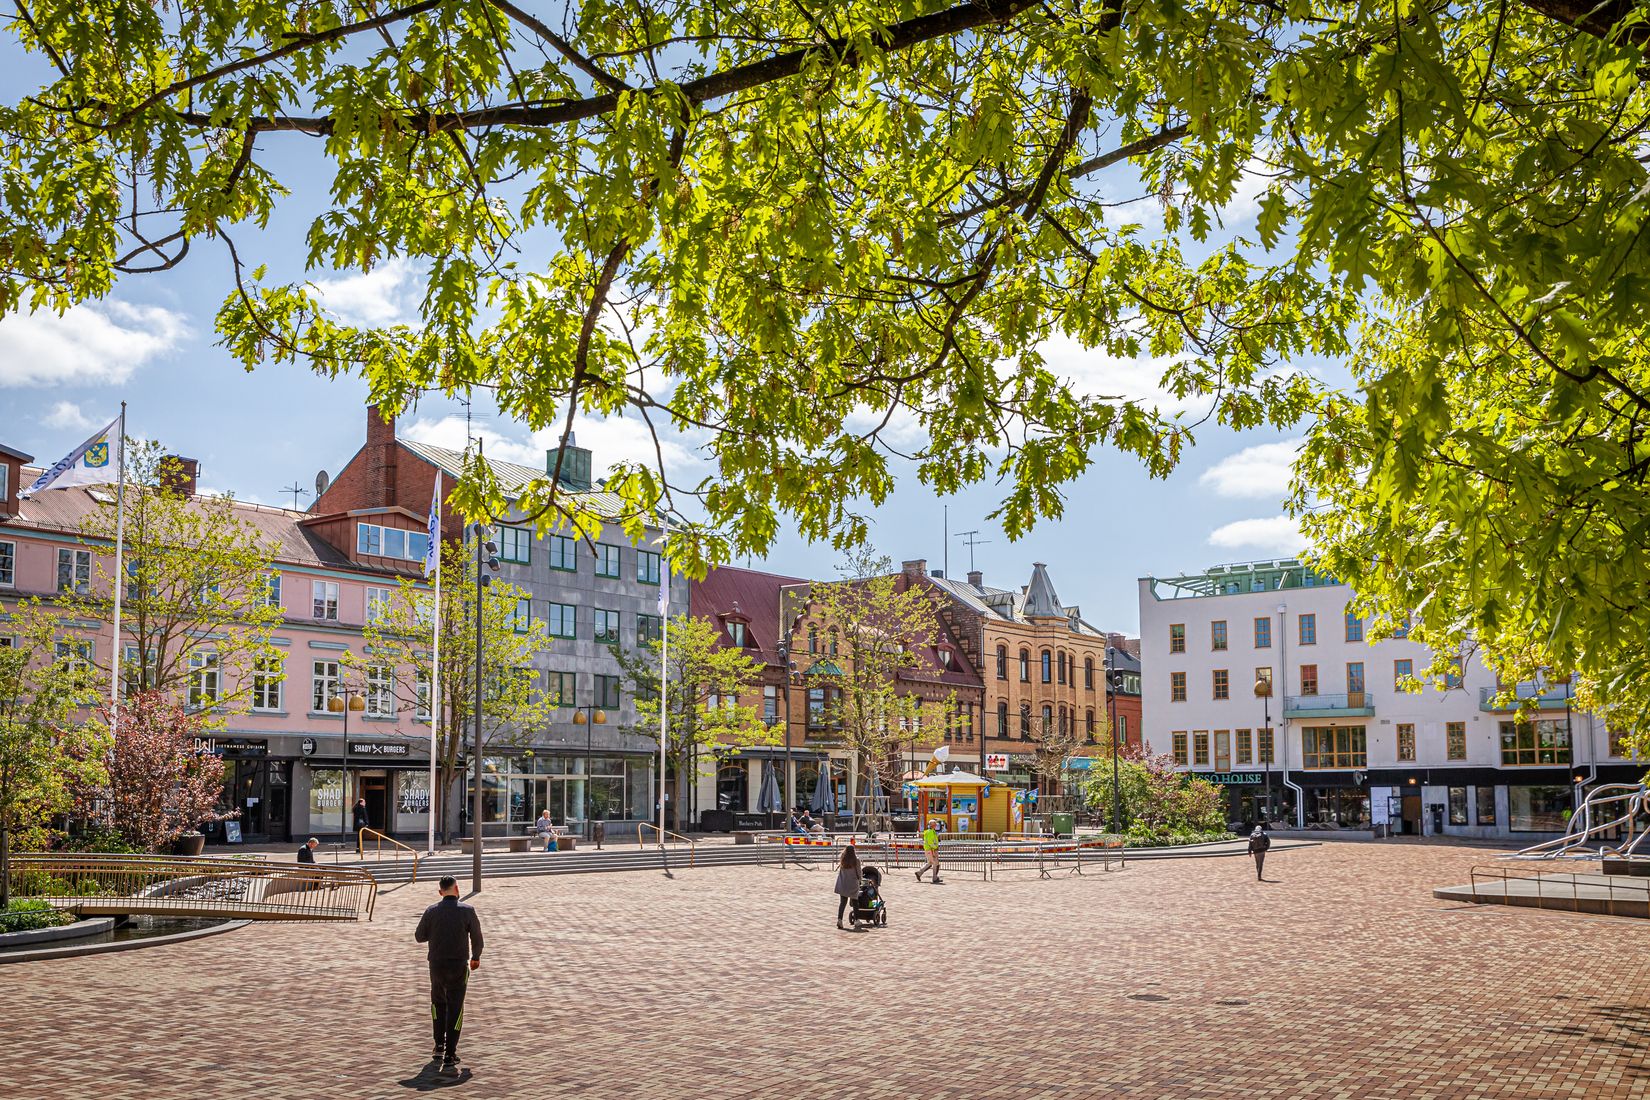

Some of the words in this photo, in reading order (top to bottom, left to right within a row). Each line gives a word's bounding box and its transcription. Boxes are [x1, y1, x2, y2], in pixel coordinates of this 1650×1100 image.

[354, 743, 372, 753] SHADY
[383, 745, 406, 754] BURGERS
[1221, 773, 1262, 784] HOUSE
[404, 788, 430, 800] SHADY
[317, 799, 344, 807] BURGER
